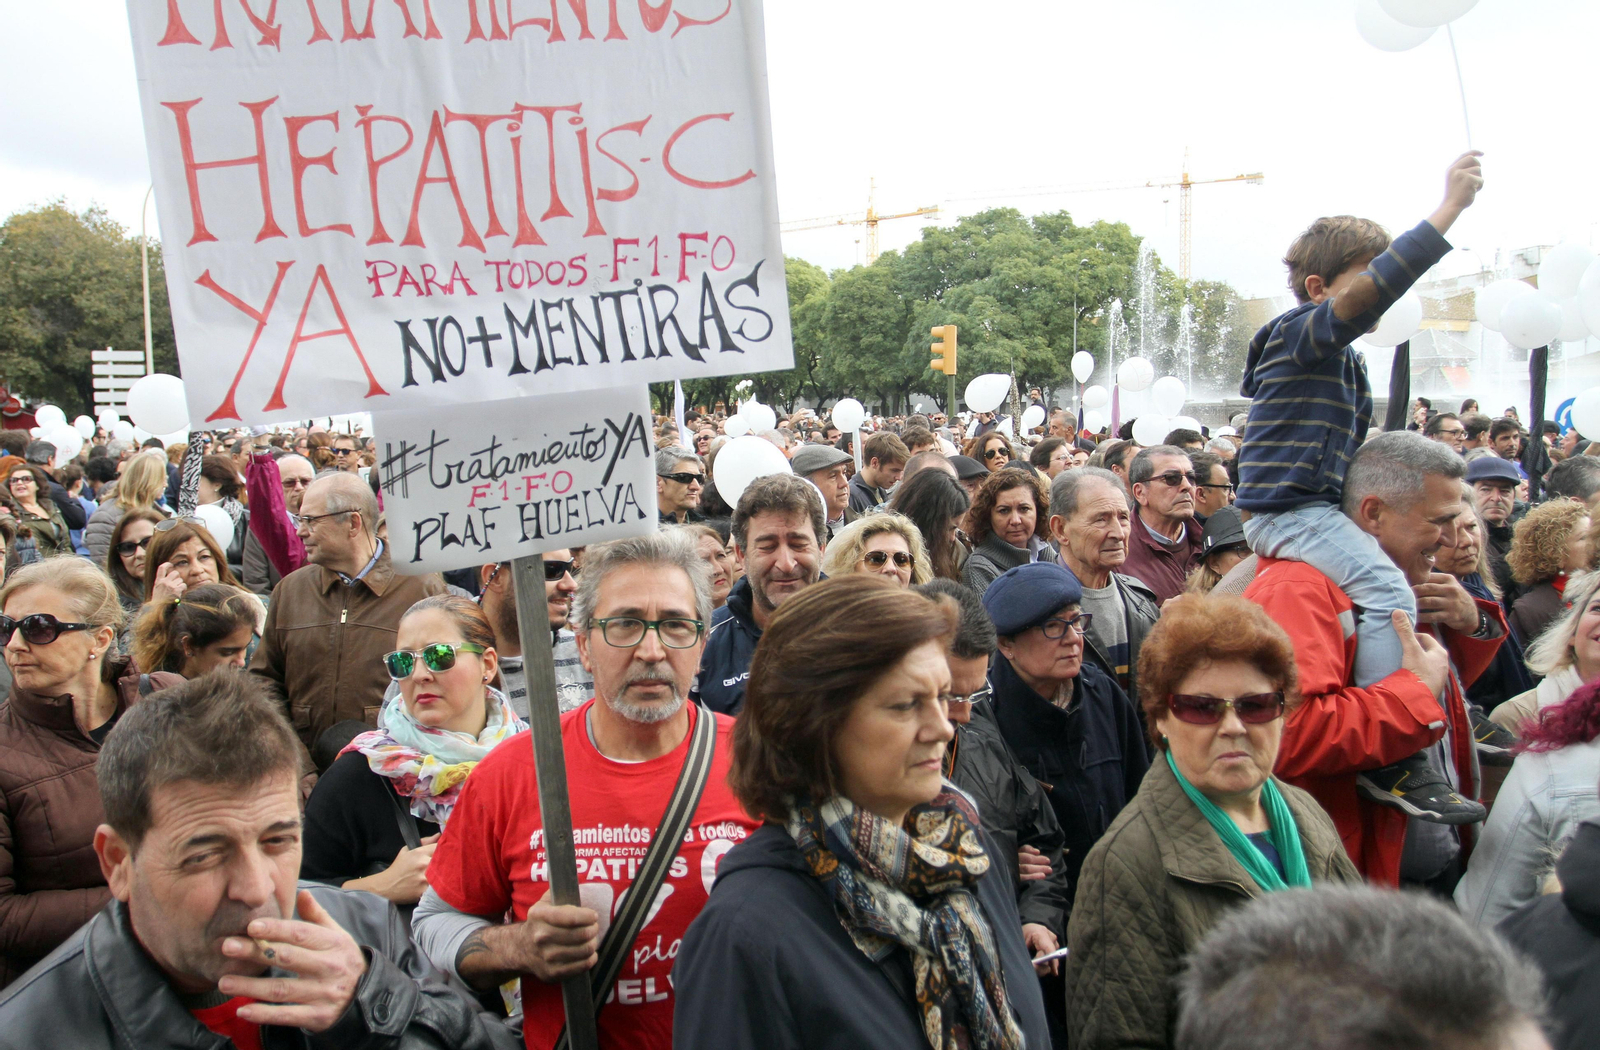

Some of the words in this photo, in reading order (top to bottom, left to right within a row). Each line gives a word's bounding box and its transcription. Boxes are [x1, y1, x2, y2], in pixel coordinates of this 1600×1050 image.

[365, 259, 478, 297] PARA
[484, 253, 589, 292] TODOS
[194, 260, 390, 422] YA
[409, 505, 501, 563] PLAF
[516, 483, 647, 543] HUELVA
[699, 821, 747, 841] tod@s
[633, 934, 682, 975] pla
